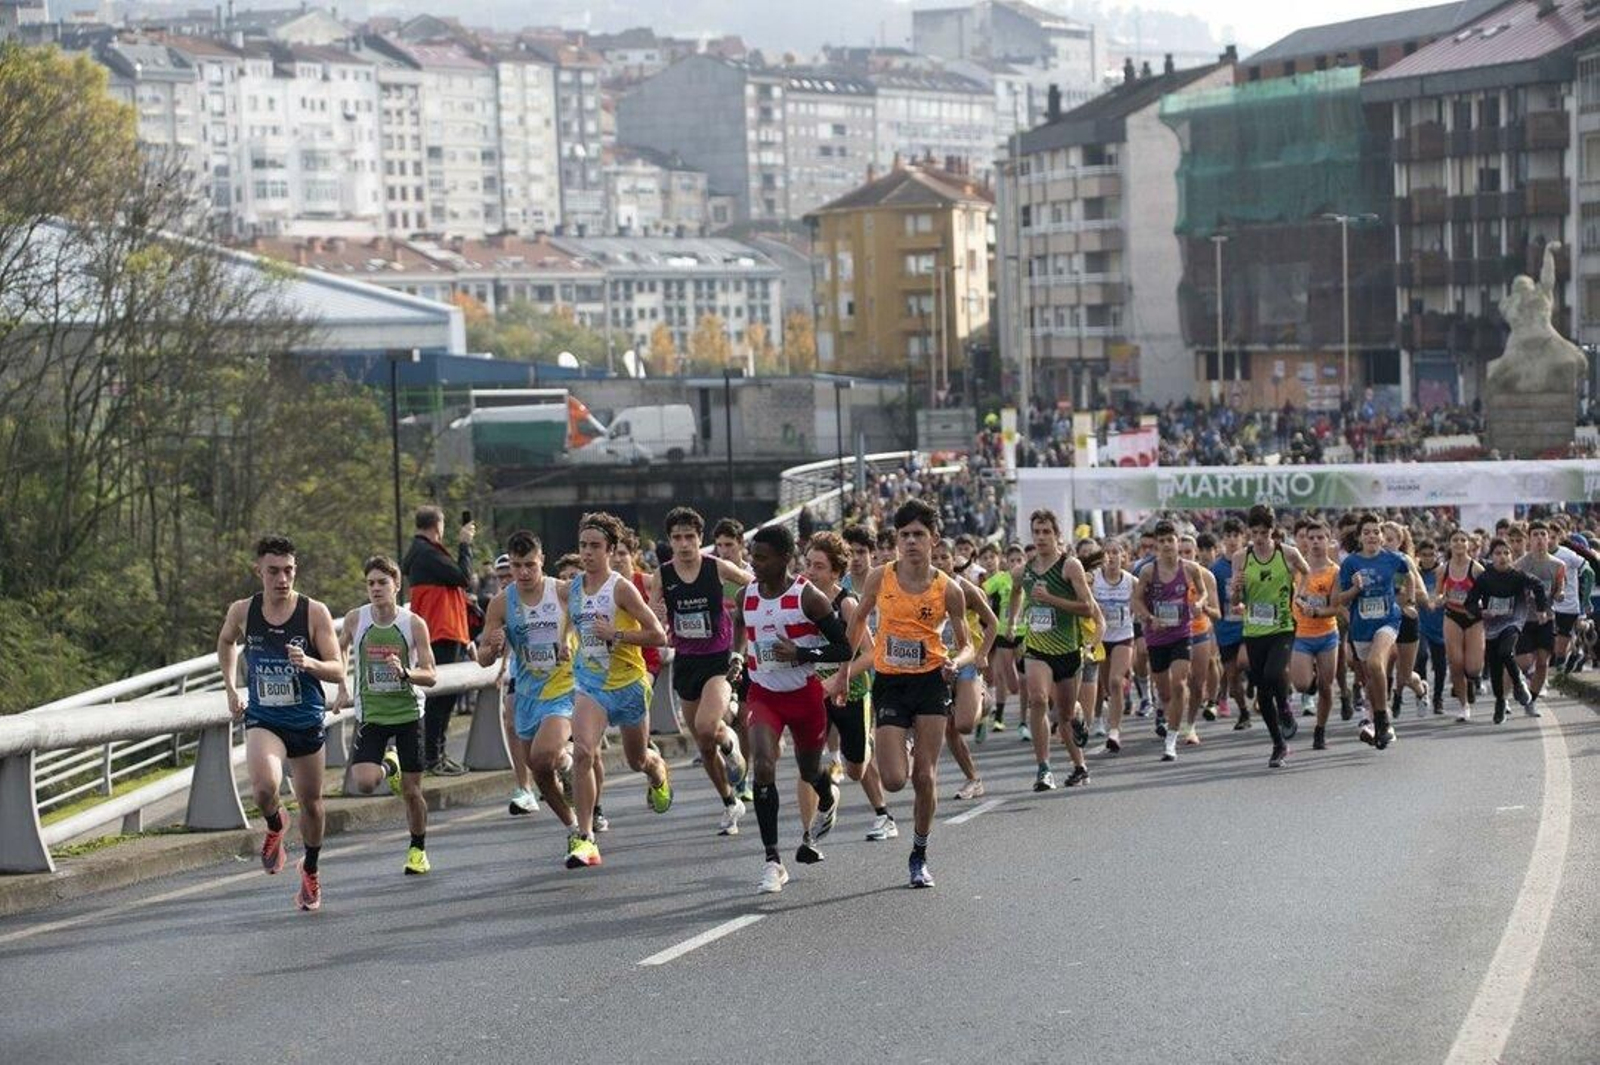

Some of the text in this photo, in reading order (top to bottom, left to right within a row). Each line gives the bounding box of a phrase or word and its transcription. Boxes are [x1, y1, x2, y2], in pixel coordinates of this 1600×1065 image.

[531, 650, 554, 661] 8004
[893, 646, 919, 658] 8048
[267, 683, 291, 696] 8001
